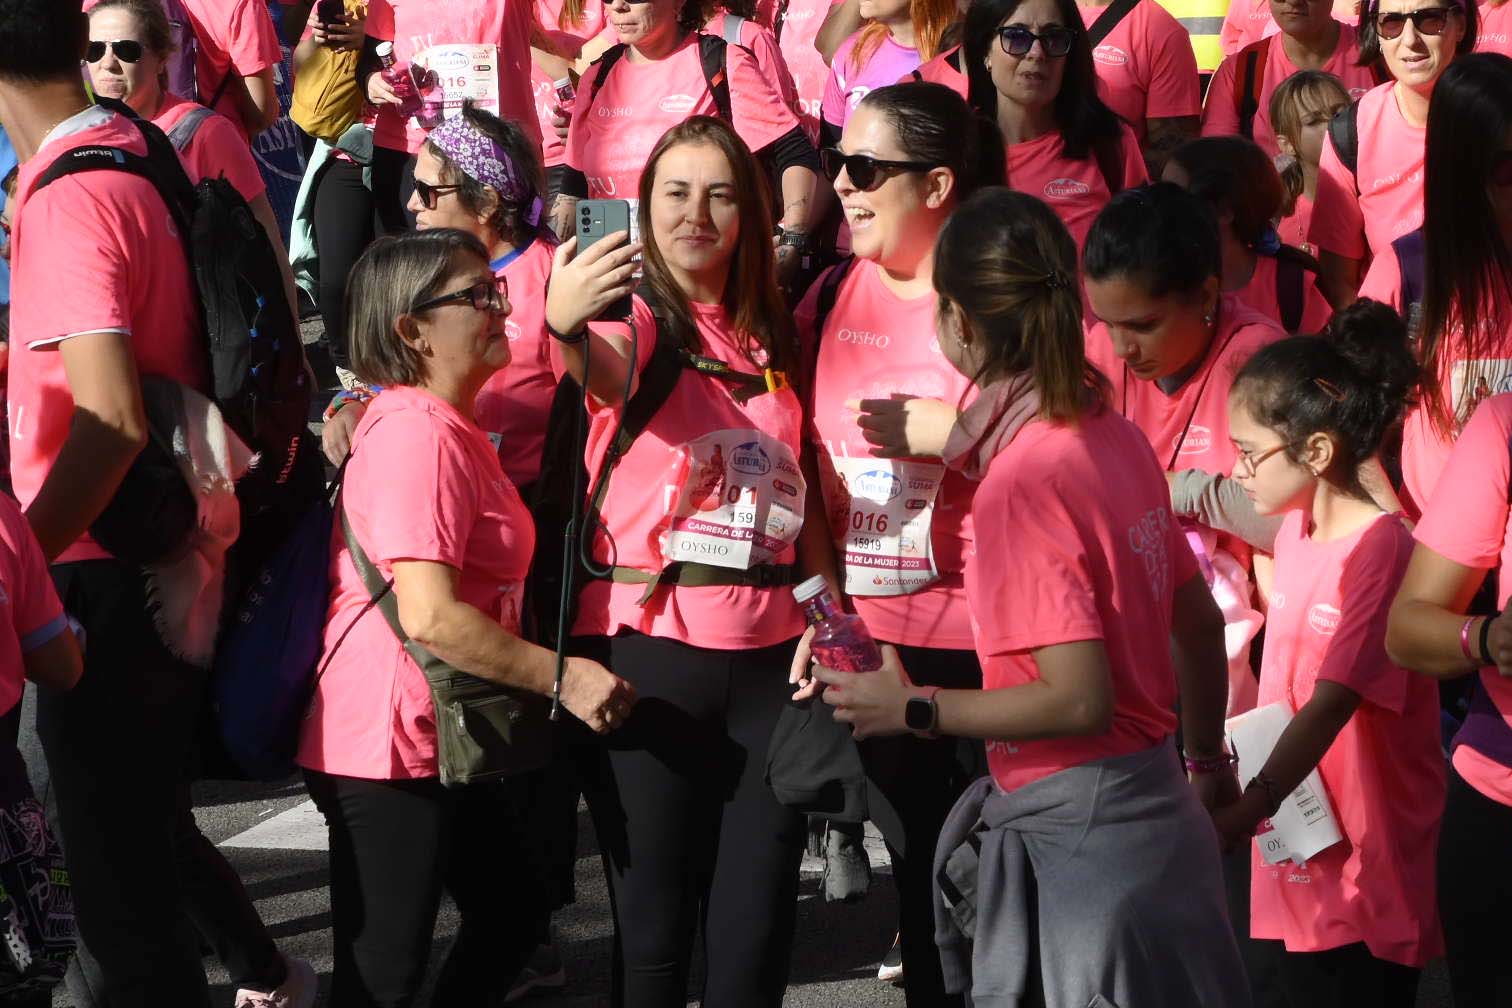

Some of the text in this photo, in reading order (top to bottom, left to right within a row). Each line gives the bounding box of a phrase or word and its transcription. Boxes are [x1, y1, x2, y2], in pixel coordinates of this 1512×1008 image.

[852, 511, 889, 533] 016
[688, 522, 729, 536] CARRERA
[731, 529, 743, 538] DE
[681, 541, 729, 556] OYSHO
[852, 536, 882, 551] 15919
[854, 556, 863, 564] DE
[864, 557, 873, 565] LA
[873, 558, 899, 567] MUJER
